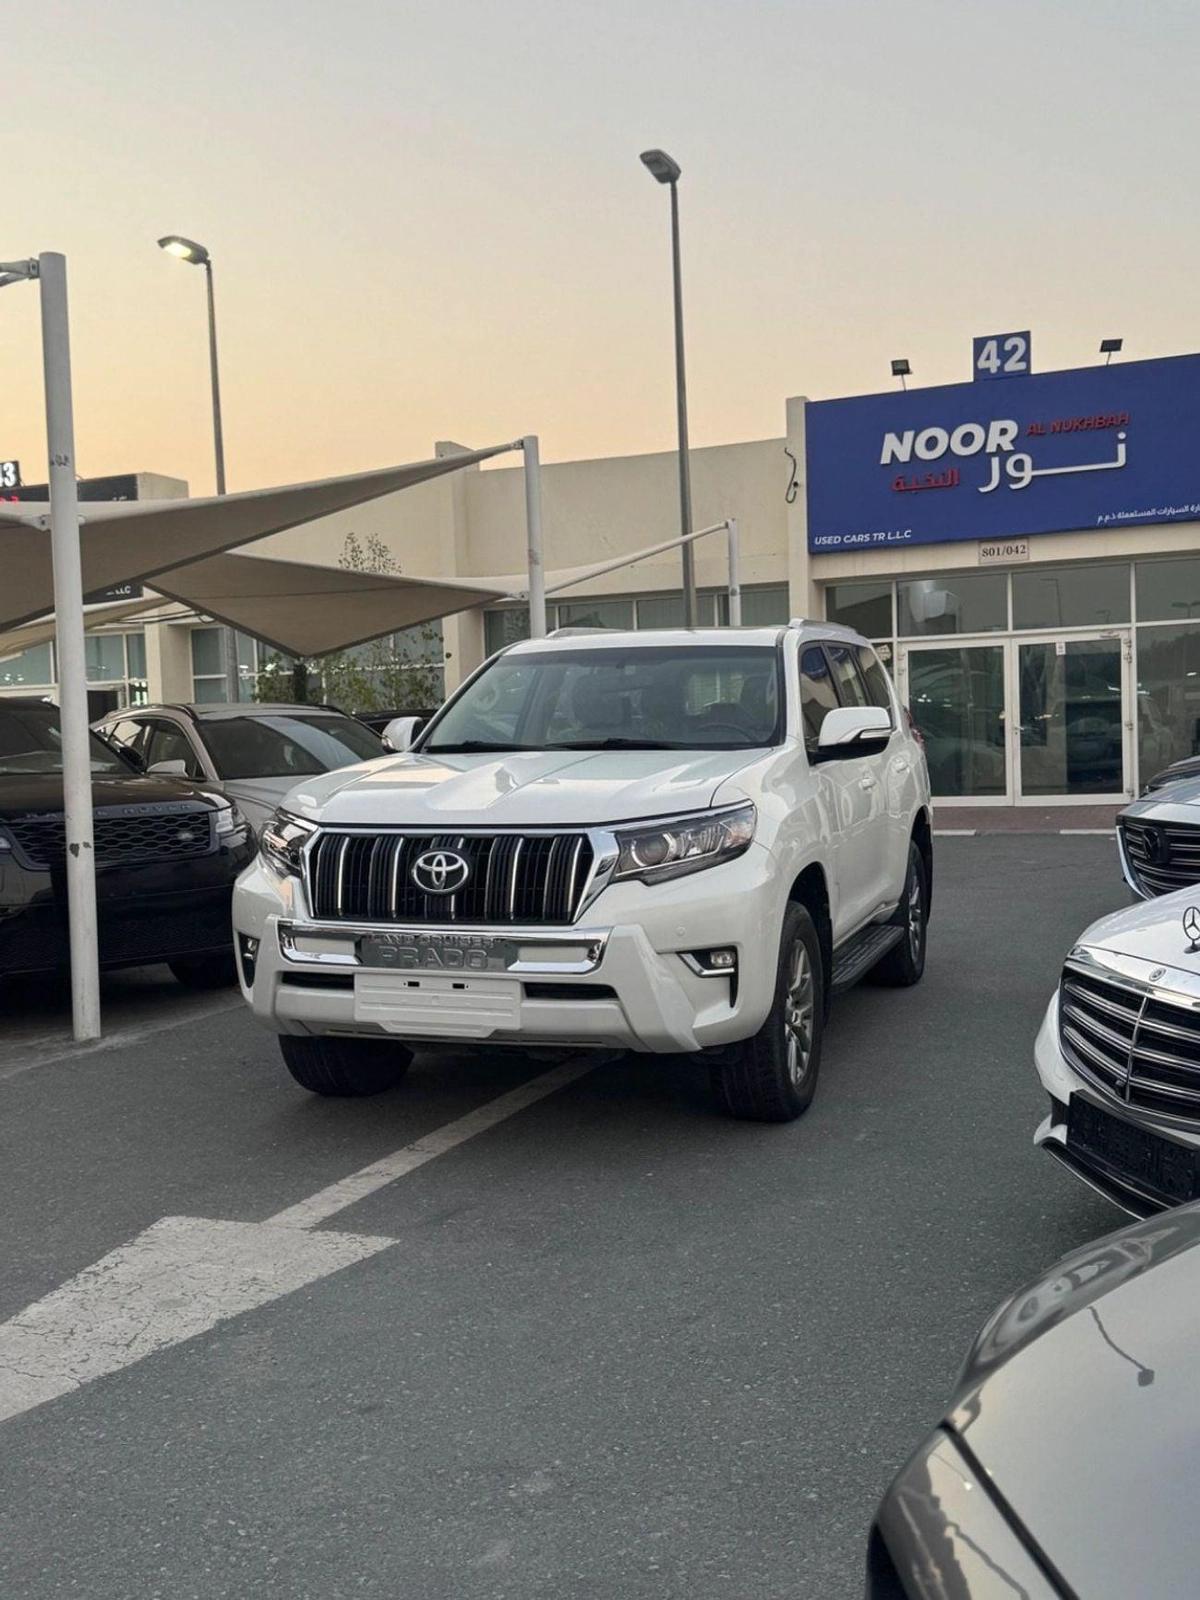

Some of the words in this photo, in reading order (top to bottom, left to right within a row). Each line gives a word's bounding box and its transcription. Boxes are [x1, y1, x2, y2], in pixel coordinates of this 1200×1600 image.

[977, 336, 1027, 373] 42
[880, 420, 1019, 464] NOOR
[1026, 423, 1045, 435] AL
[1050, 412, 1130, 433] NUKHBAH
[815, 536, 841, 545] USED
[843, 534, 870, 543] CARS
[873, 532, 885, 541] TR
[982, 545, 1026, 557] 801/042
[379, 945, 488, 969] PRADO
